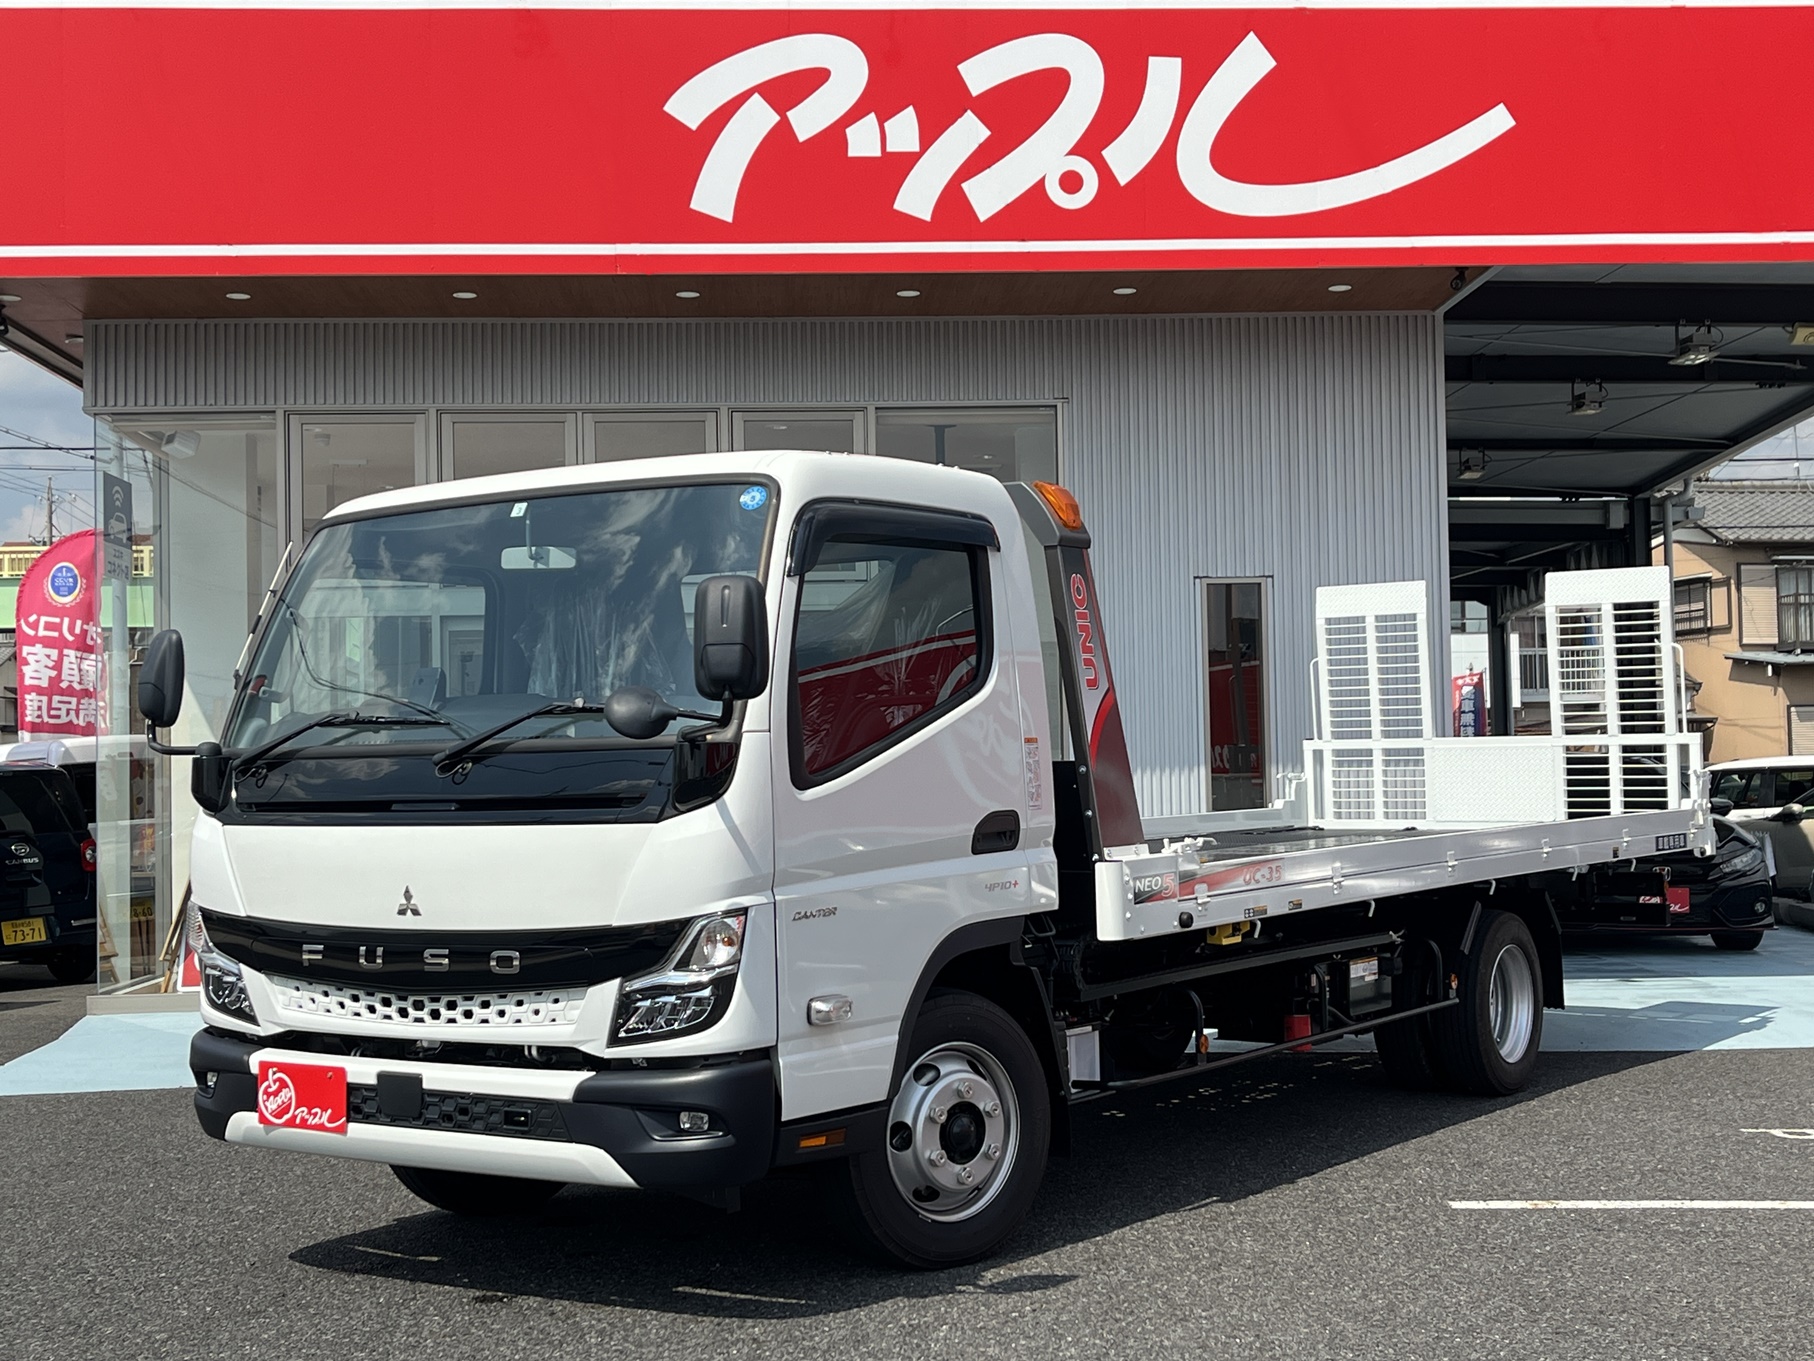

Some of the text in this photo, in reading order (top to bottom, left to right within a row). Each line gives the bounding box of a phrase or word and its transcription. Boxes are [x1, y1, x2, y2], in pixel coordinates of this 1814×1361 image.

[662, 31, 1517, 222] アップル
[1070, 573, 1099, 690] UNIC
[1243, 865, 1282, 886] UC-35
[792, 906, 838, 921] CANTER
[302, 944, 520, 975] FUSO
[294, 1106, 346, 1128] アップル
